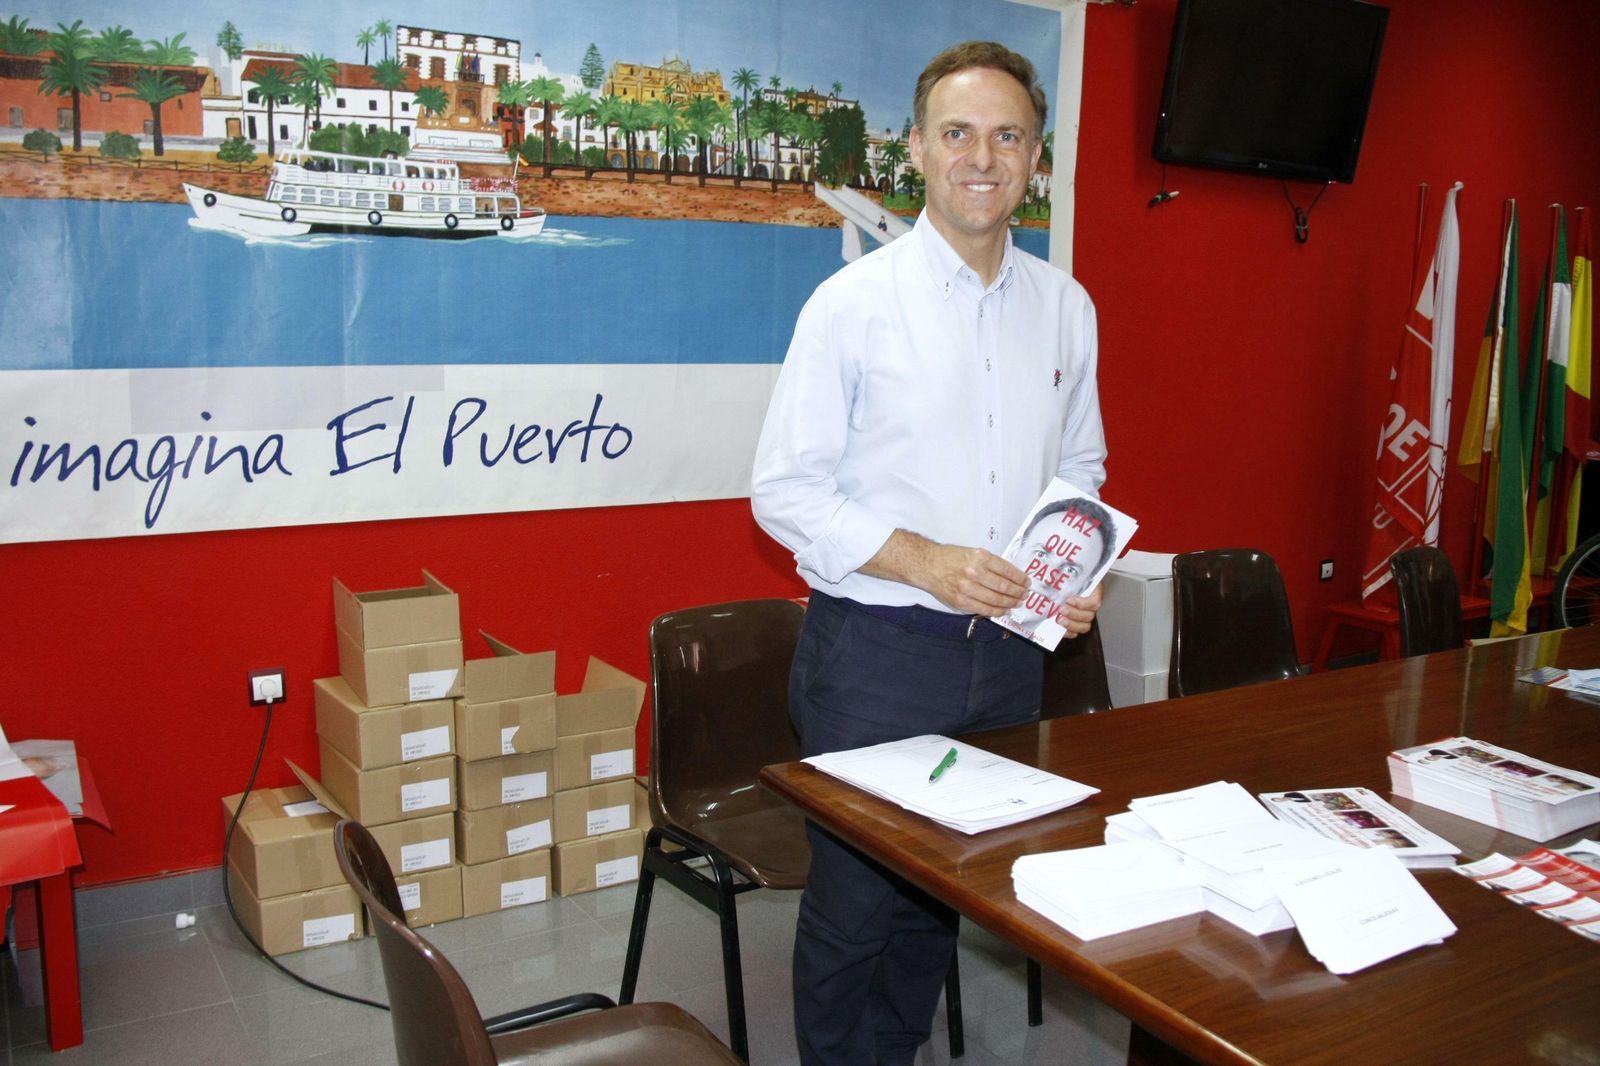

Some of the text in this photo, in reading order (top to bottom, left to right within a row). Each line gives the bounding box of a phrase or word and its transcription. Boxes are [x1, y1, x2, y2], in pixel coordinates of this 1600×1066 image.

[10, 393, 633, 529] imagina El Puerto
[1061, 505, 1102, 538] HAZ
[1045, 534, 1082, 563] QUE
[1025, 558, 1070, 591] PASE
[1025, 591, 1064, 624] UEV
